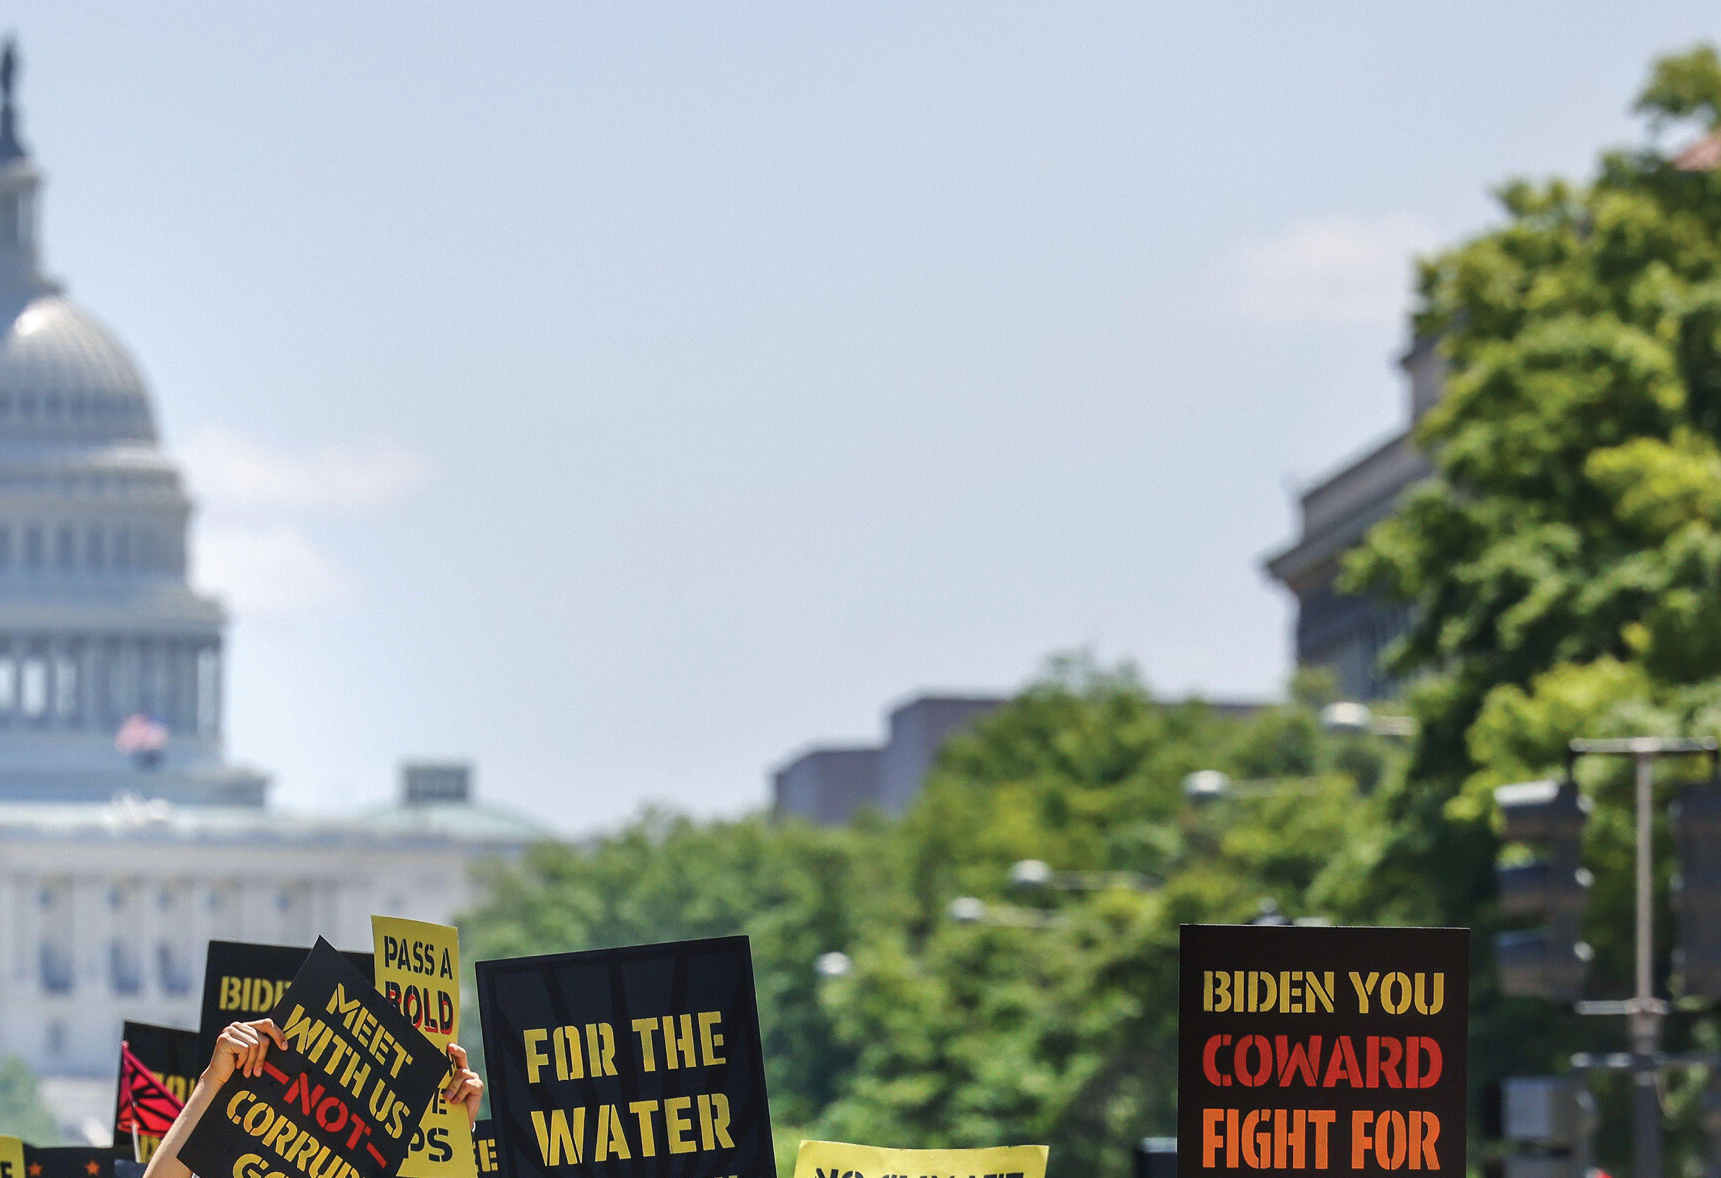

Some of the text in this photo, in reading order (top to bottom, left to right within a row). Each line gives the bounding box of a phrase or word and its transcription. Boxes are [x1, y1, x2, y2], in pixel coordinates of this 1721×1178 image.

[384, 935, 453, 980] PASS A
[1203, 970, 1445, 1015] BIDEN YOU
[325, 983, 414, 1079] MEET
[524, 1010, 727, 1083] FOR THE
[1202, 1034, 1443, 1089] COWARD
[281, 1004, 372, 1099] WITH
[369, 1078, 412, 1139] US
[531, 1092, 736, 1167] WATER
[1201, 1108, 1440, 1171] FIGHT FOR
